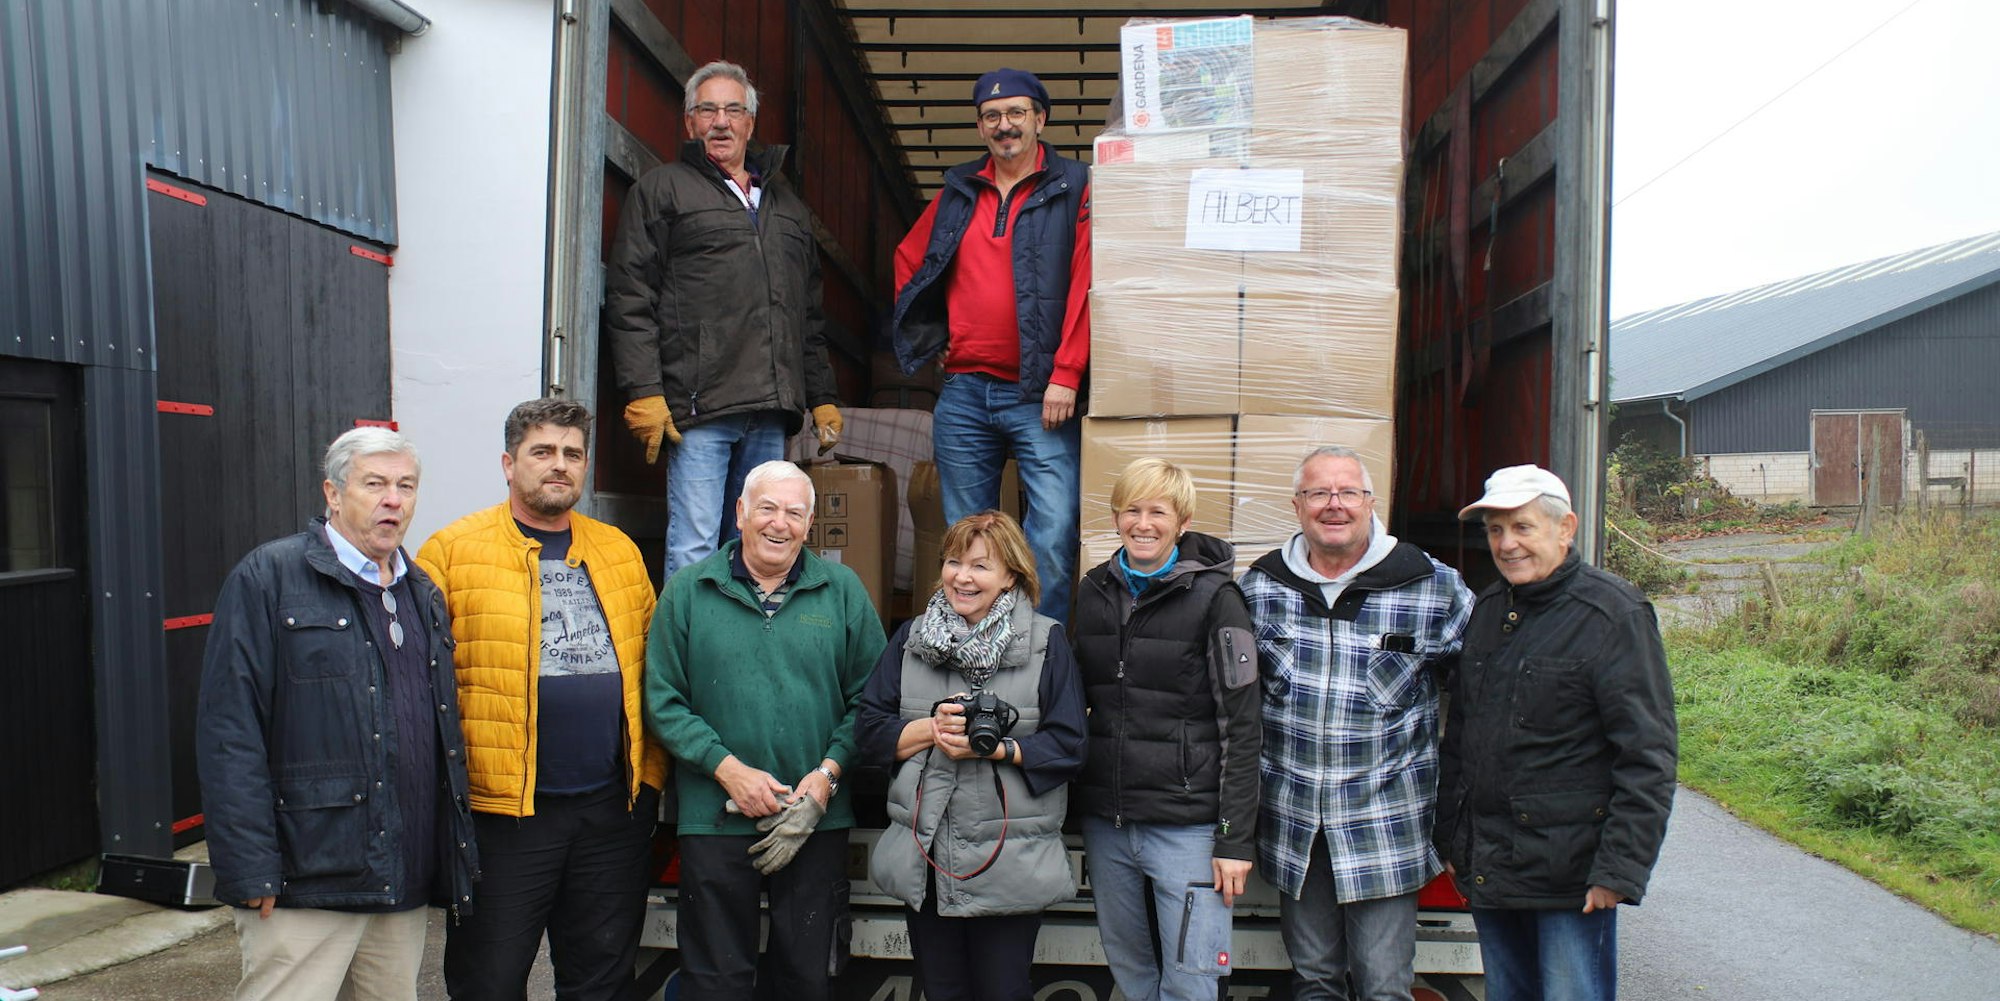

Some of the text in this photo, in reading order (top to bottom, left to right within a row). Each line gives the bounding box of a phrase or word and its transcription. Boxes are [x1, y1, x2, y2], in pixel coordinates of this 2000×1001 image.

[1133, 44, 1146, 108] GARDENA
[1202, 190, 1299, 225] ALBERT
[555, 572, 573, 583] OF
[554, 588, 573, 597] 1989
[554, 620, 600, 644] Angeles
